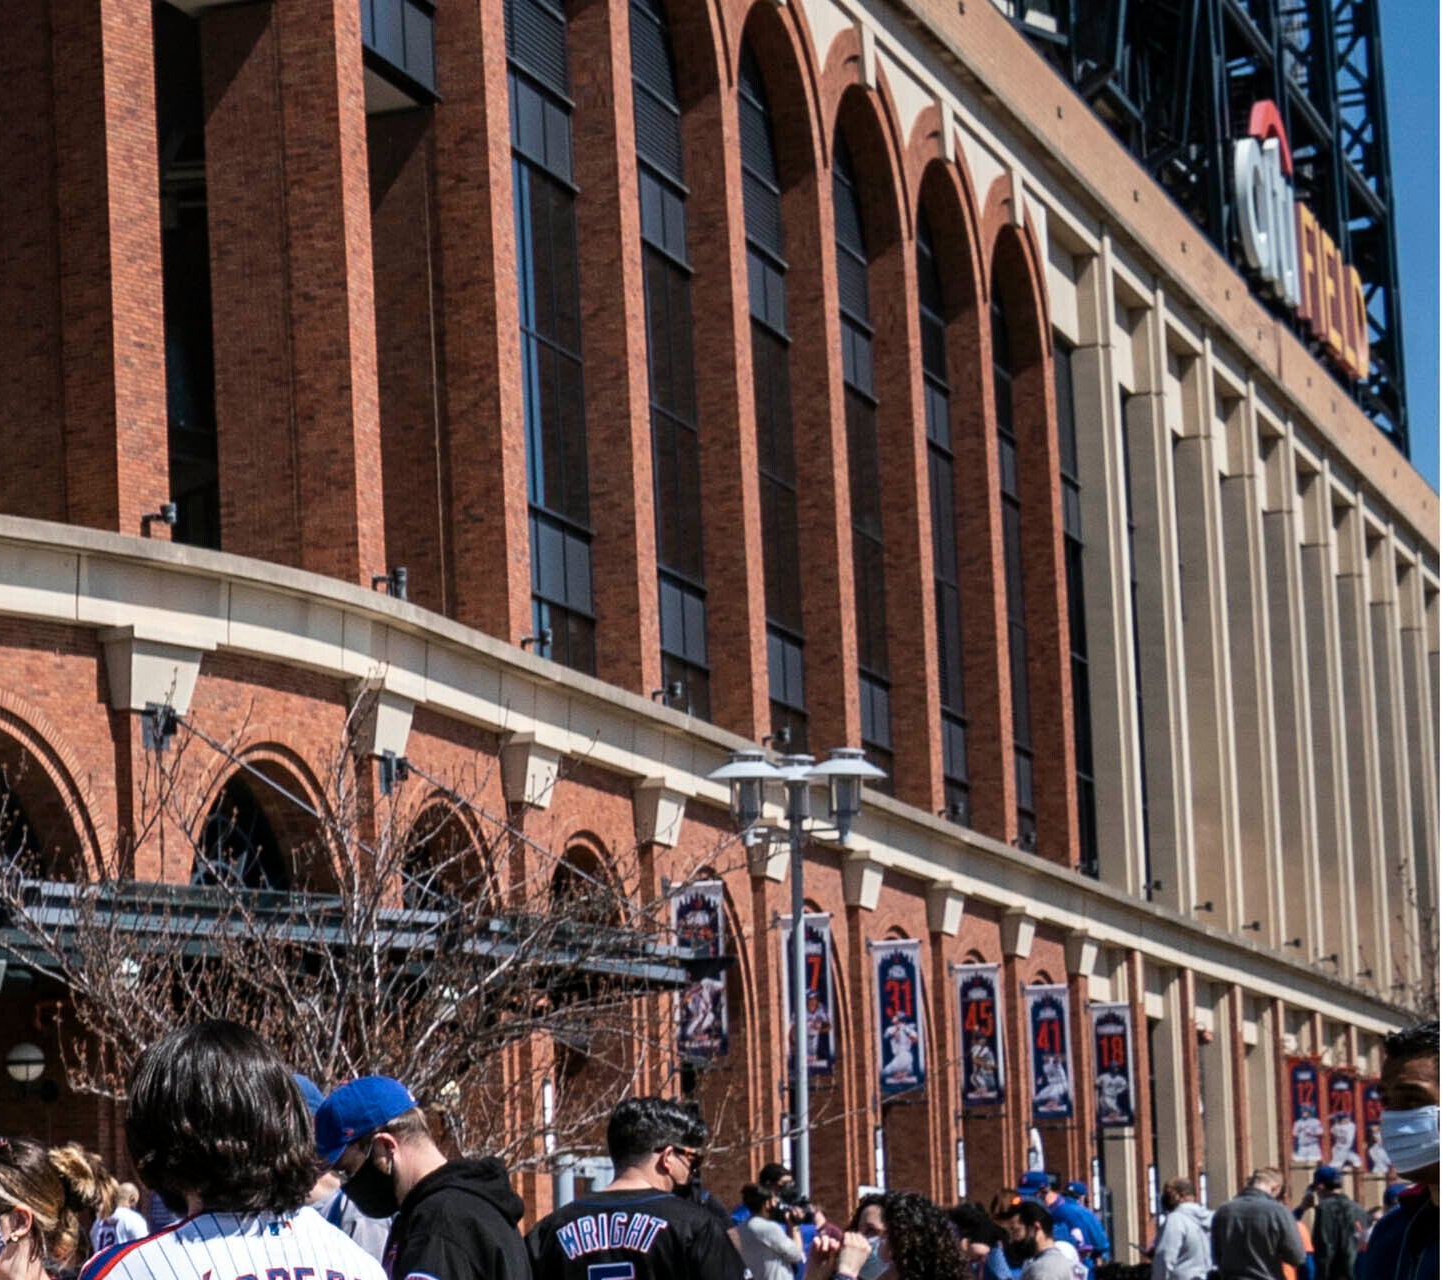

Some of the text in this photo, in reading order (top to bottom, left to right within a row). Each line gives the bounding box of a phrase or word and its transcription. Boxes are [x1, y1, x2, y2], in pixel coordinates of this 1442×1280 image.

[885, 979, 913, 1018] 31
[964, 1000, 994, 1037] 45
[1036, 1019, 1061, 1053] 41
[1099, 1035, 1124, 1067] 18
[556, 1212, 666, 1260] WRIGHT
